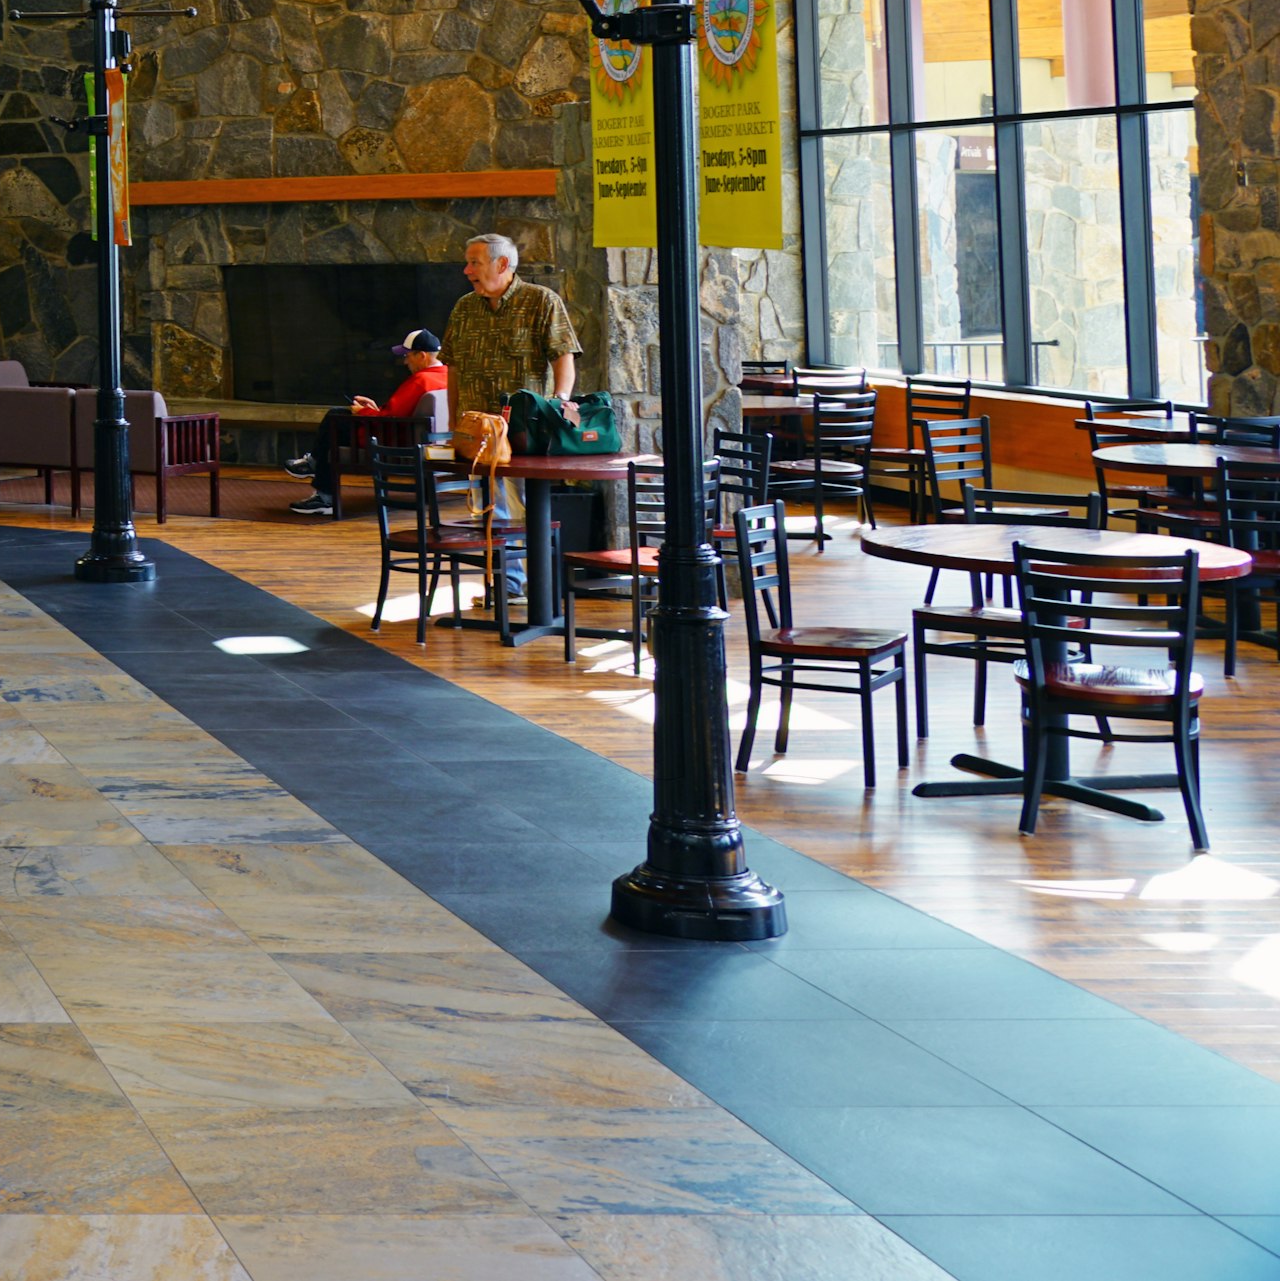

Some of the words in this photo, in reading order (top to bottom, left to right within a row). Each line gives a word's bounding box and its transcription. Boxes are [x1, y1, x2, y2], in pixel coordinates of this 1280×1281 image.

[703, 103, 737, 119] BOGERT
[737, 101, 762, 116] PARK
[597, 117, 633, 131] BOGERT
[699, 124, 734, 139] ARMERS'
[735, 121, 777, 136] MARKET
[594, 135, 626, 149] ARMERS'
[702, 149, 737, 168] Tuesdays,
[739, 147, 768, 168] 5-8pm
[596, 158, 630, 176] Tuesdays,
[704, 174, 767, 196] June-September
